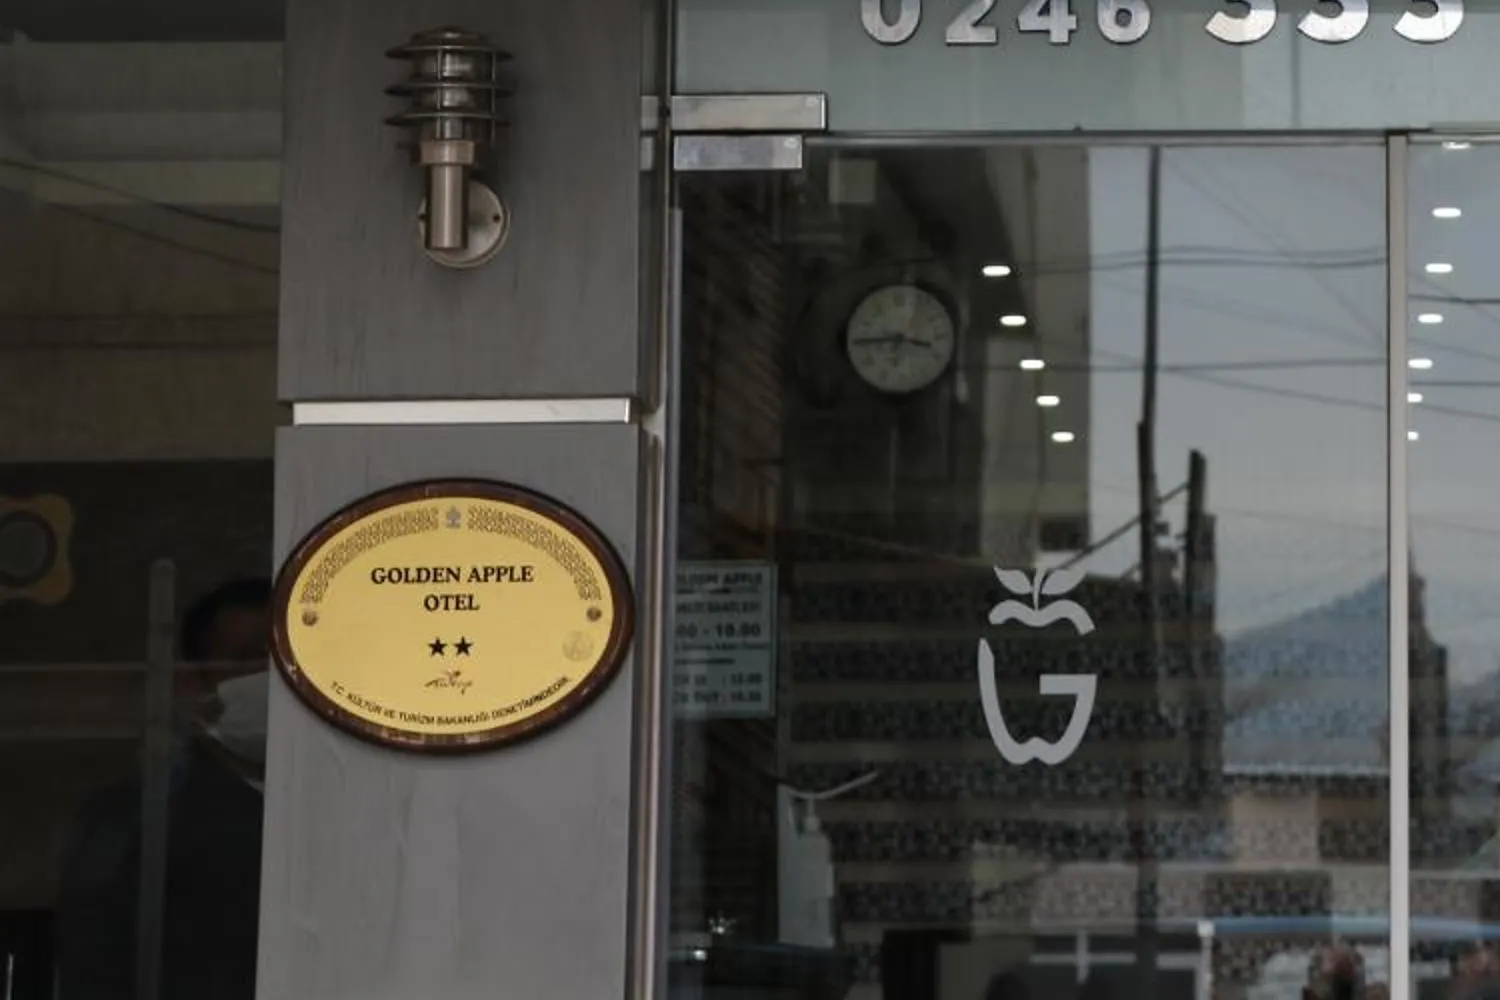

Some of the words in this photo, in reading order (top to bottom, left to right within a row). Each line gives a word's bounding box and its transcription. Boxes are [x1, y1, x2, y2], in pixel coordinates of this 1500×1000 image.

[370, 566, 461, 585] GOLDEN
[466, 565, 535, 584] APPLE
[423, 594, 480, 612] OTEL
